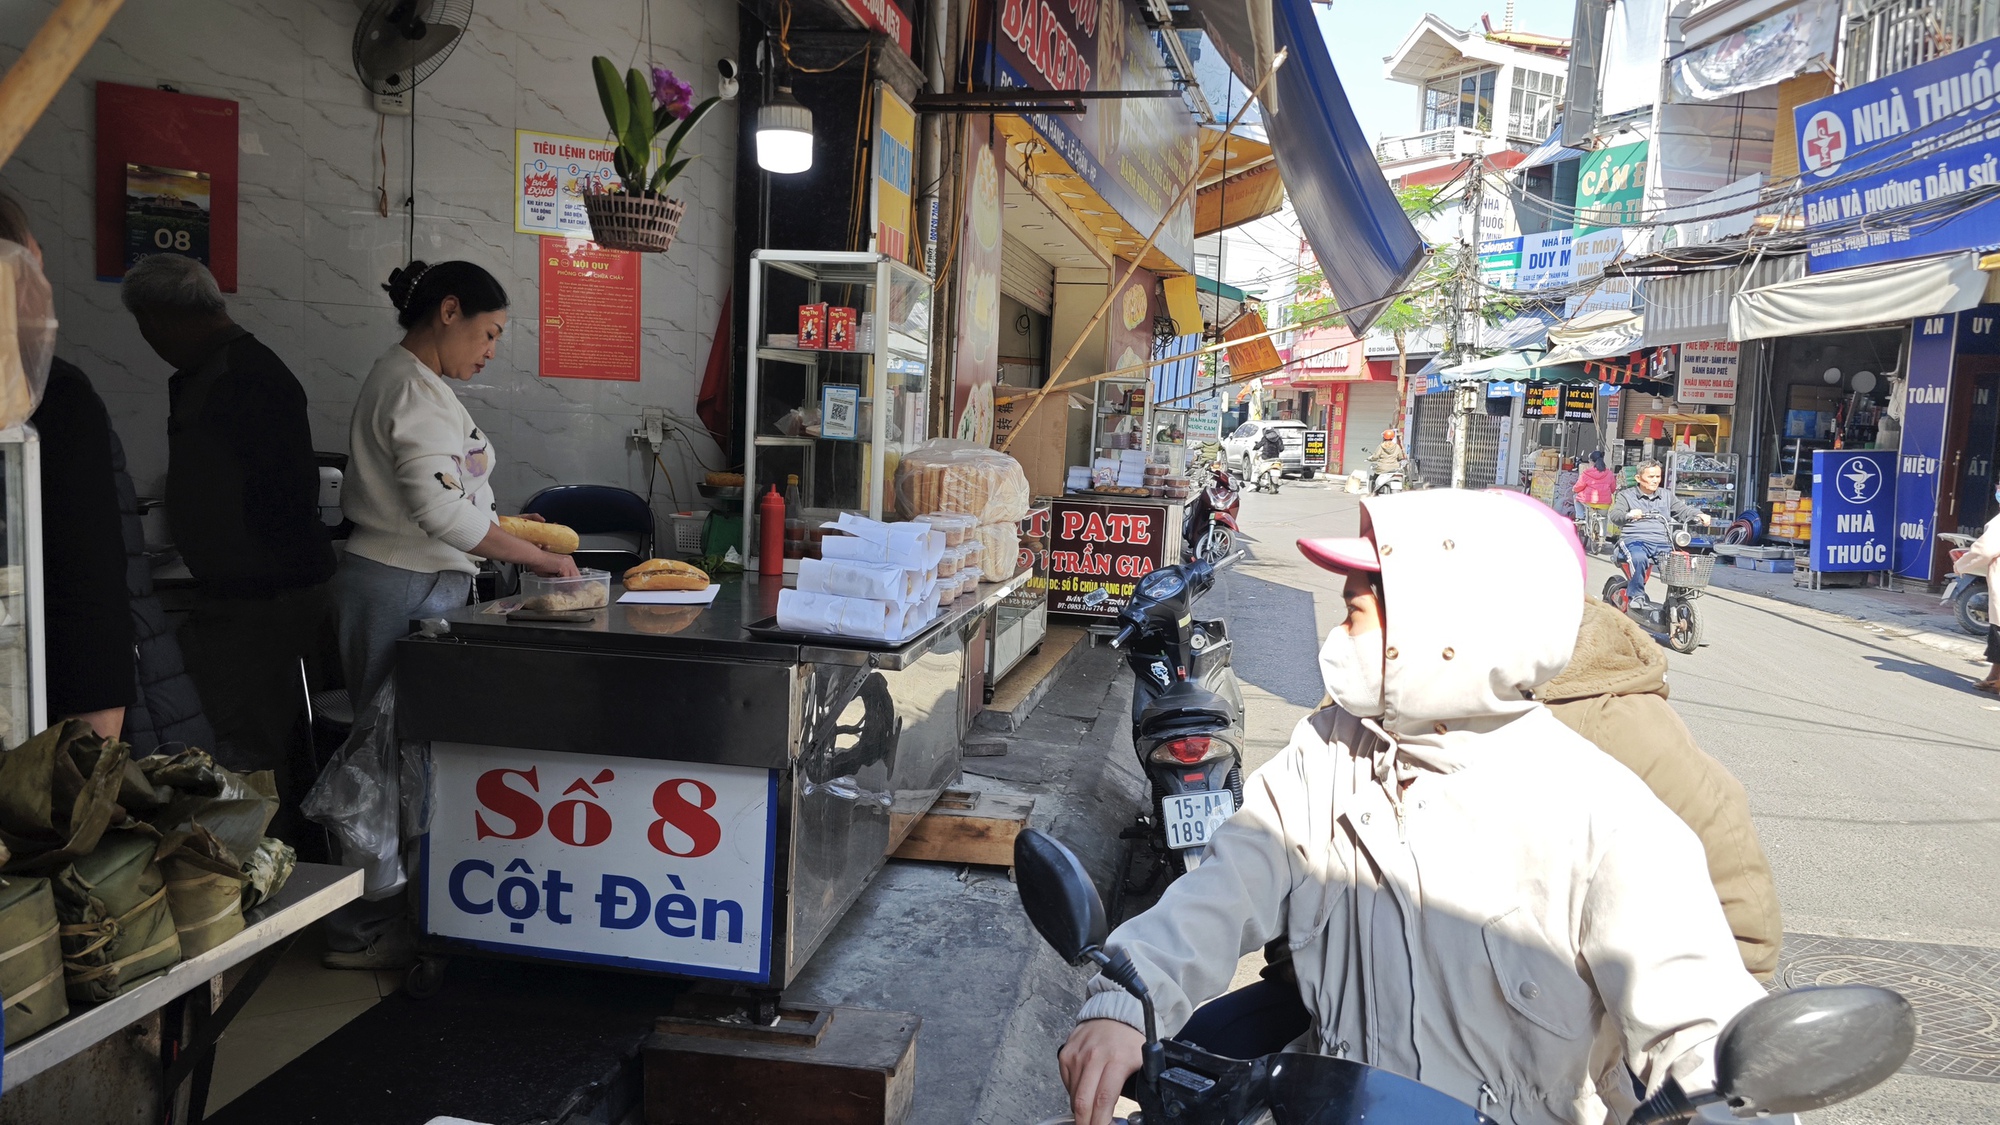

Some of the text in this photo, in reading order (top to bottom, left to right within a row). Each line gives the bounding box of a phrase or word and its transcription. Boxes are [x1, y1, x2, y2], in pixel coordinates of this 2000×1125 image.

[1852, 87, 1910, 146] NHÀ
[533, 141, 616, 163] TIÊU LỆNH CHỮA
[1581, 155, 1631, 197] CẦM
[1807, 196, 1840, 226] BÁN
[1840, 188, 1863, 218] VÀ
[1864, 178, 1922, 213] HƯỚNG
[1924, 162, 1965, 201] DẪN
[154, 228, 191, 251] 08
[1542, 236, 1559, 248] NHÀ
[1576, 236, 1618, 256] XE MÁY
[573, 259, 609, 270] NỘI QUY
[1529, 251, 1556, 270] DUY
[1923, 318, 1945, 335] AN
[1972, 317, 1993, 334] UY
[1908, 384, 1946, 404] TOÀN
[1903, 453, 1936, 478] HIỆU
[1061, 510, 1151, 546] PATE
[1836, 510, 1875, 534] NHÀ
[1900, 518, 1925, 541] QUẢ
[1052, 543, 1154, 579] TRẦN GIA
[1826, 538, 1886, 565] THUỐC
[1061, 575, 1072, 591] SỐ
[1072, 576, 1079, 592] 6
[475, 764, 722, 858] Số 8
[448, 857, 744, 944] Cột Đèn
